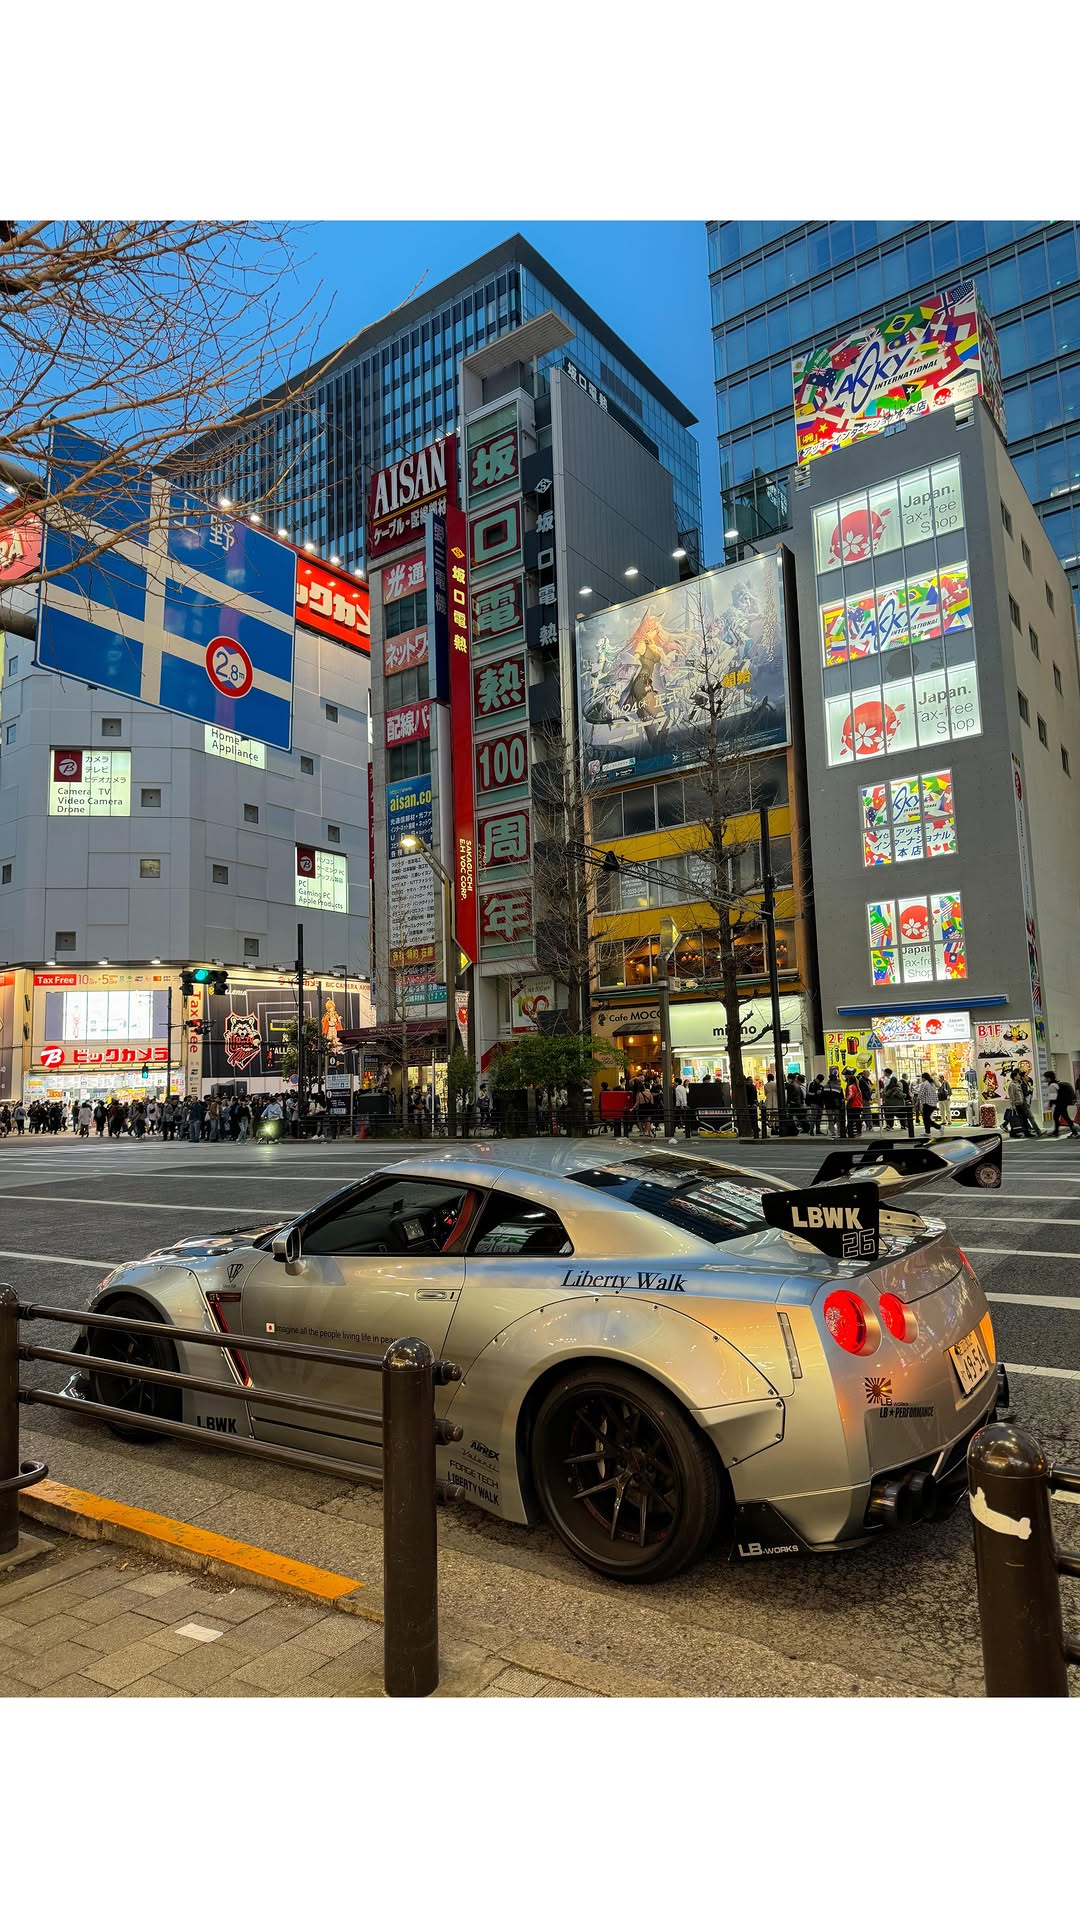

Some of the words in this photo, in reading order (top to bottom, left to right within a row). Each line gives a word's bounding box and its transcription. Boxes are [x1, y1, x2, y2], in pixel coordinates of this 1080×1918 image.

[874, 359, 938, 391] INTERNATIONAL
[373, 440, 447, 519] AISAN
[385, 560, 428, 601] 光通
[536, 509, 558, 647] 坂口電熱
[452, 565, 468, 655] 坂口電熱
[386, 632, 429, 668] ネットワ
[211, 728, 240, 745] Home
[212, 740, 259, 762] Appliance
[57, 787, 91, 795] Camera
[57, 797, 85, 805] Video
[87, 797, 123, 806] Camera
[57, 805, 85, 813] Drone
[897, 846, 922, 857] 本店
[298, 888, 322, 899] Gaming
[322, 892, 331, 900] PC
[298, 896, 317, 905] Apple
[317, 900, 343, 910] Products
[55, 976, 74, 984] Free
[190, 991, 201, 1017] Tax
[713, 1025, 756, 1036] mino
[828, 1033, 844, 1044] 2F
[978, 1025, 1001, 1036] B1F
[73, 1048, 168, 1063] ビックカメラ
[791, 1206, 863, 1229] LBWK
[842, 1228, 875, 1259] 26
[560, 1269, 631, 1294] Liberty
[637, 1271, 688, 1292] Walk
[300, 1327, 308, 1335] all
[308, 1328, 319, 1336] the
[319, 1330, 342, 1339] people
[342, 1331, 360, 1342] living
[360, 1333, 372, 1341] life
[197, 1415, 238, 1433] LBWK
[449, 1460, 476, 1478] FORGE
[476, 1472, 499, 1489] TECH
[448, 1471, 478, 1493] LIBERTY
[478, 1486, 499, 1506] WALK
